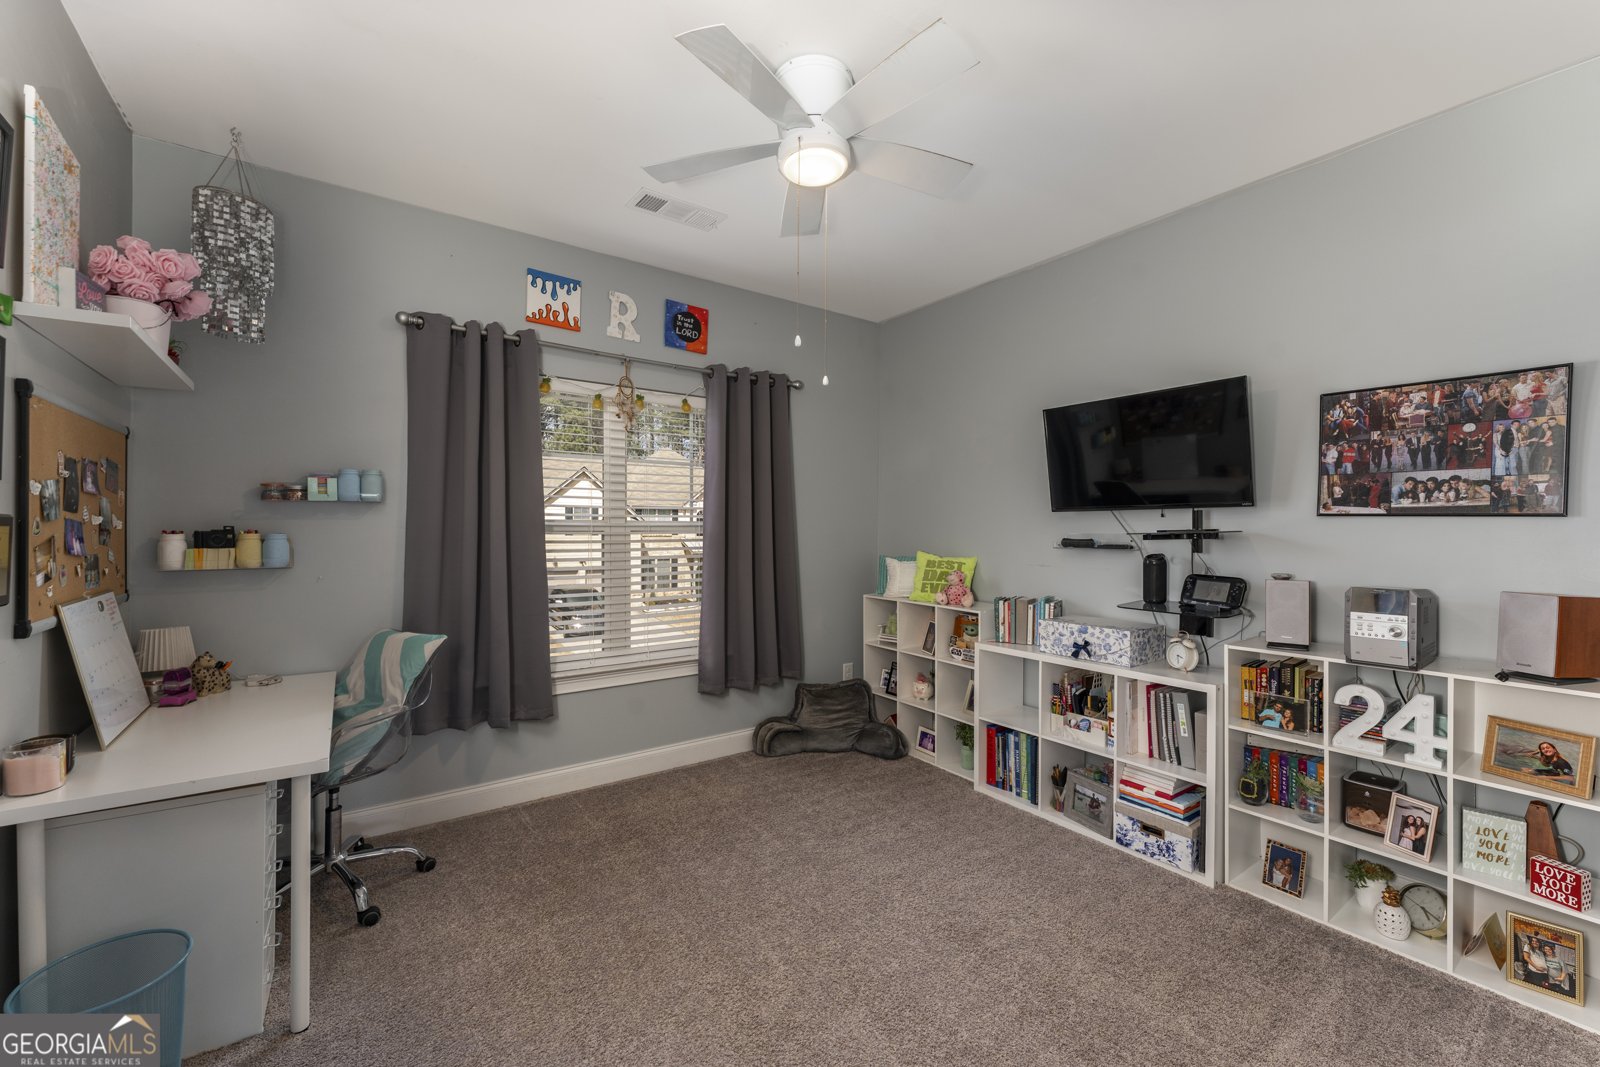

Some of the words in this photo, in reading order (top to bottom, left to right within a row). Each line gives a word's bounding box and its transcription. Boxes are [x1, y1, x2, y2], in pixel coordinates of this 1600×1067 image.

[606, 290, 641, 343] R
[677, 314, 694, 323] Trust
[676, 326, 699, 339] LORD
[925, 559, 966, 572] BEST
[922, 569, 950, 582] DA
[1332, 683, 1449, 769] 24
[1476, 826, 1510, 841] LOVE
[1479, 838, 1508, 853] YOU
[1476, 850, 1511, 866] MORE
[1534, 861, 1576, 886] LOVE
[1539, 873, 1573, 894] YOU
[1533, 882, 1579, 909] MORE
